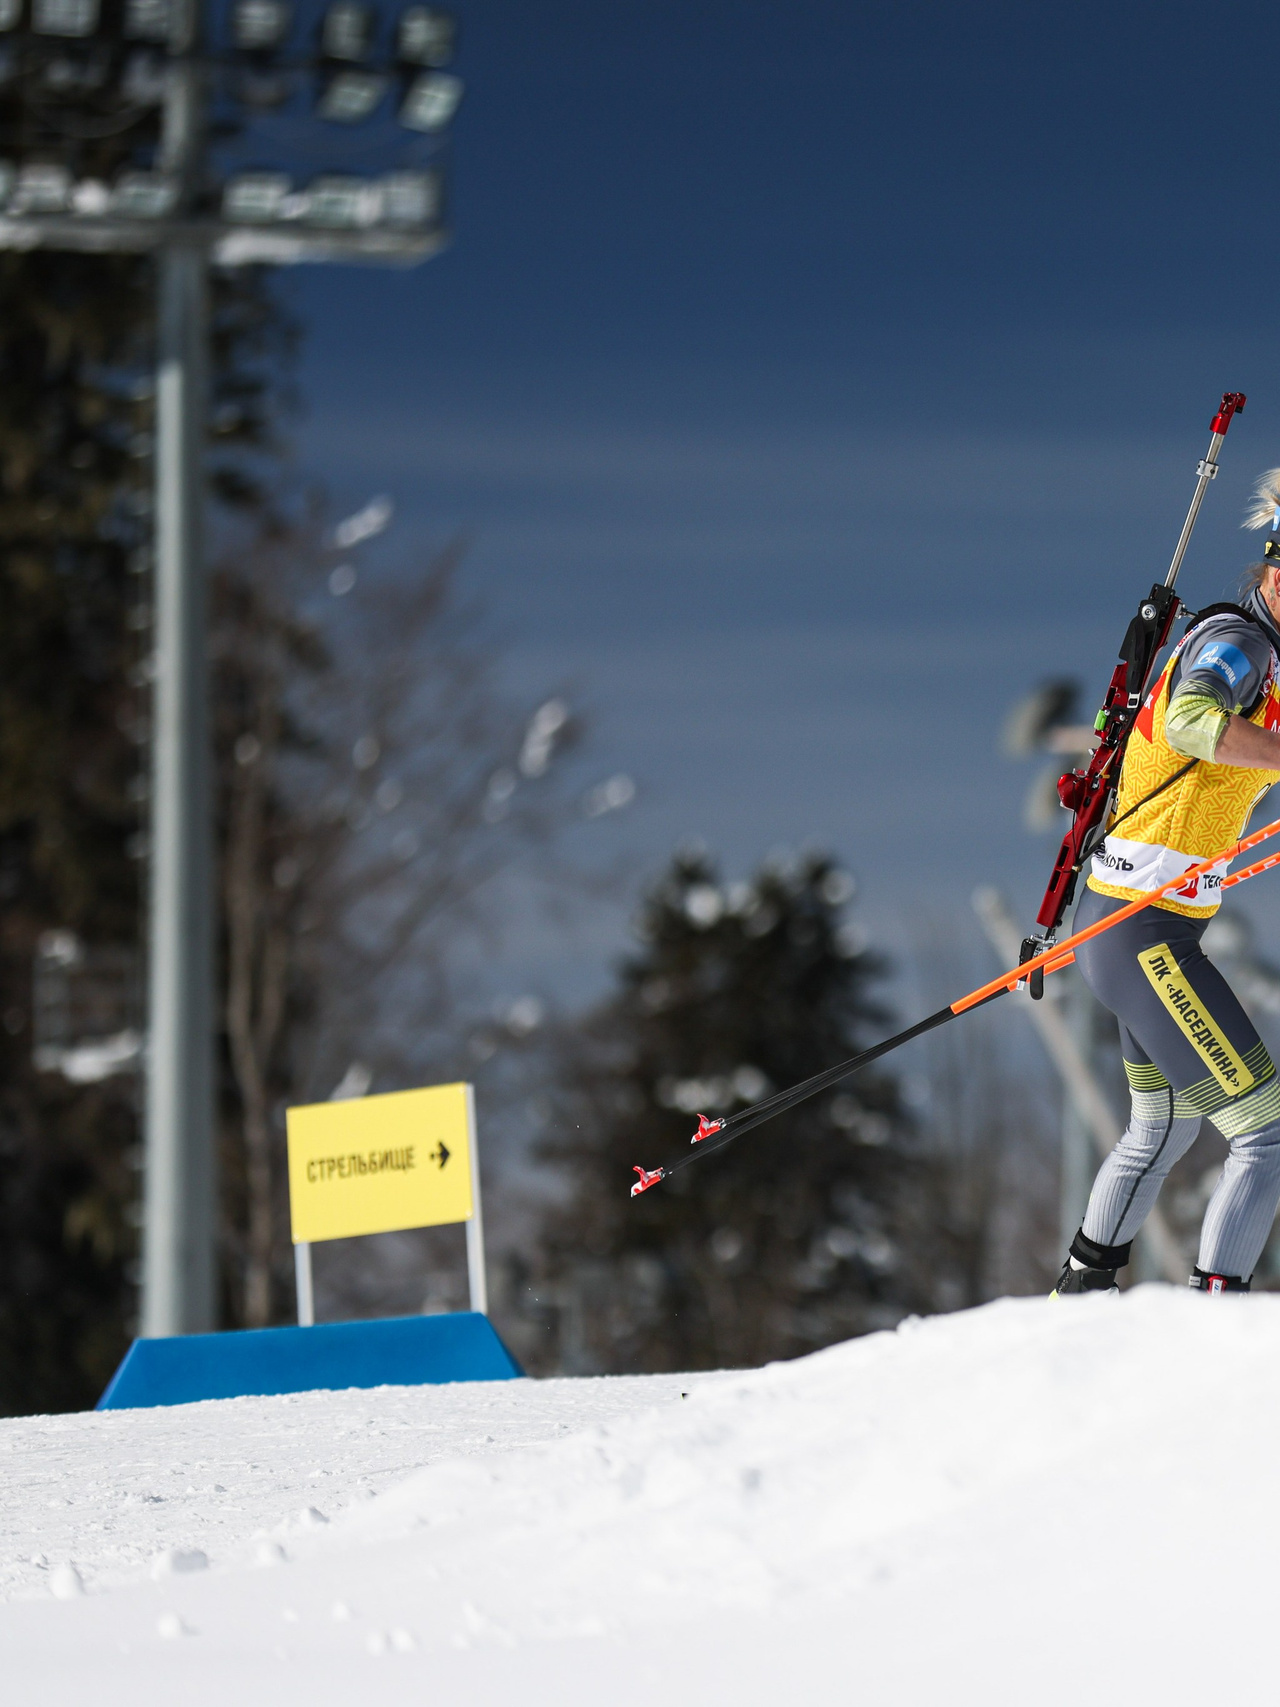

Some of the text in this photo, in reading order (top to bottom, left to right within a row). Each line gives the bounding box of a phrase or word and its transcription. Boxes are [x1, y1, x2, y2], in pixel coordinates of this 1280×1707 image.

[1147, 955, 1240, 1087] ЛК «НАСЕДКИНА»
[306, 1146, 417, 1184] СТРЕЛЬБИЩЕ
